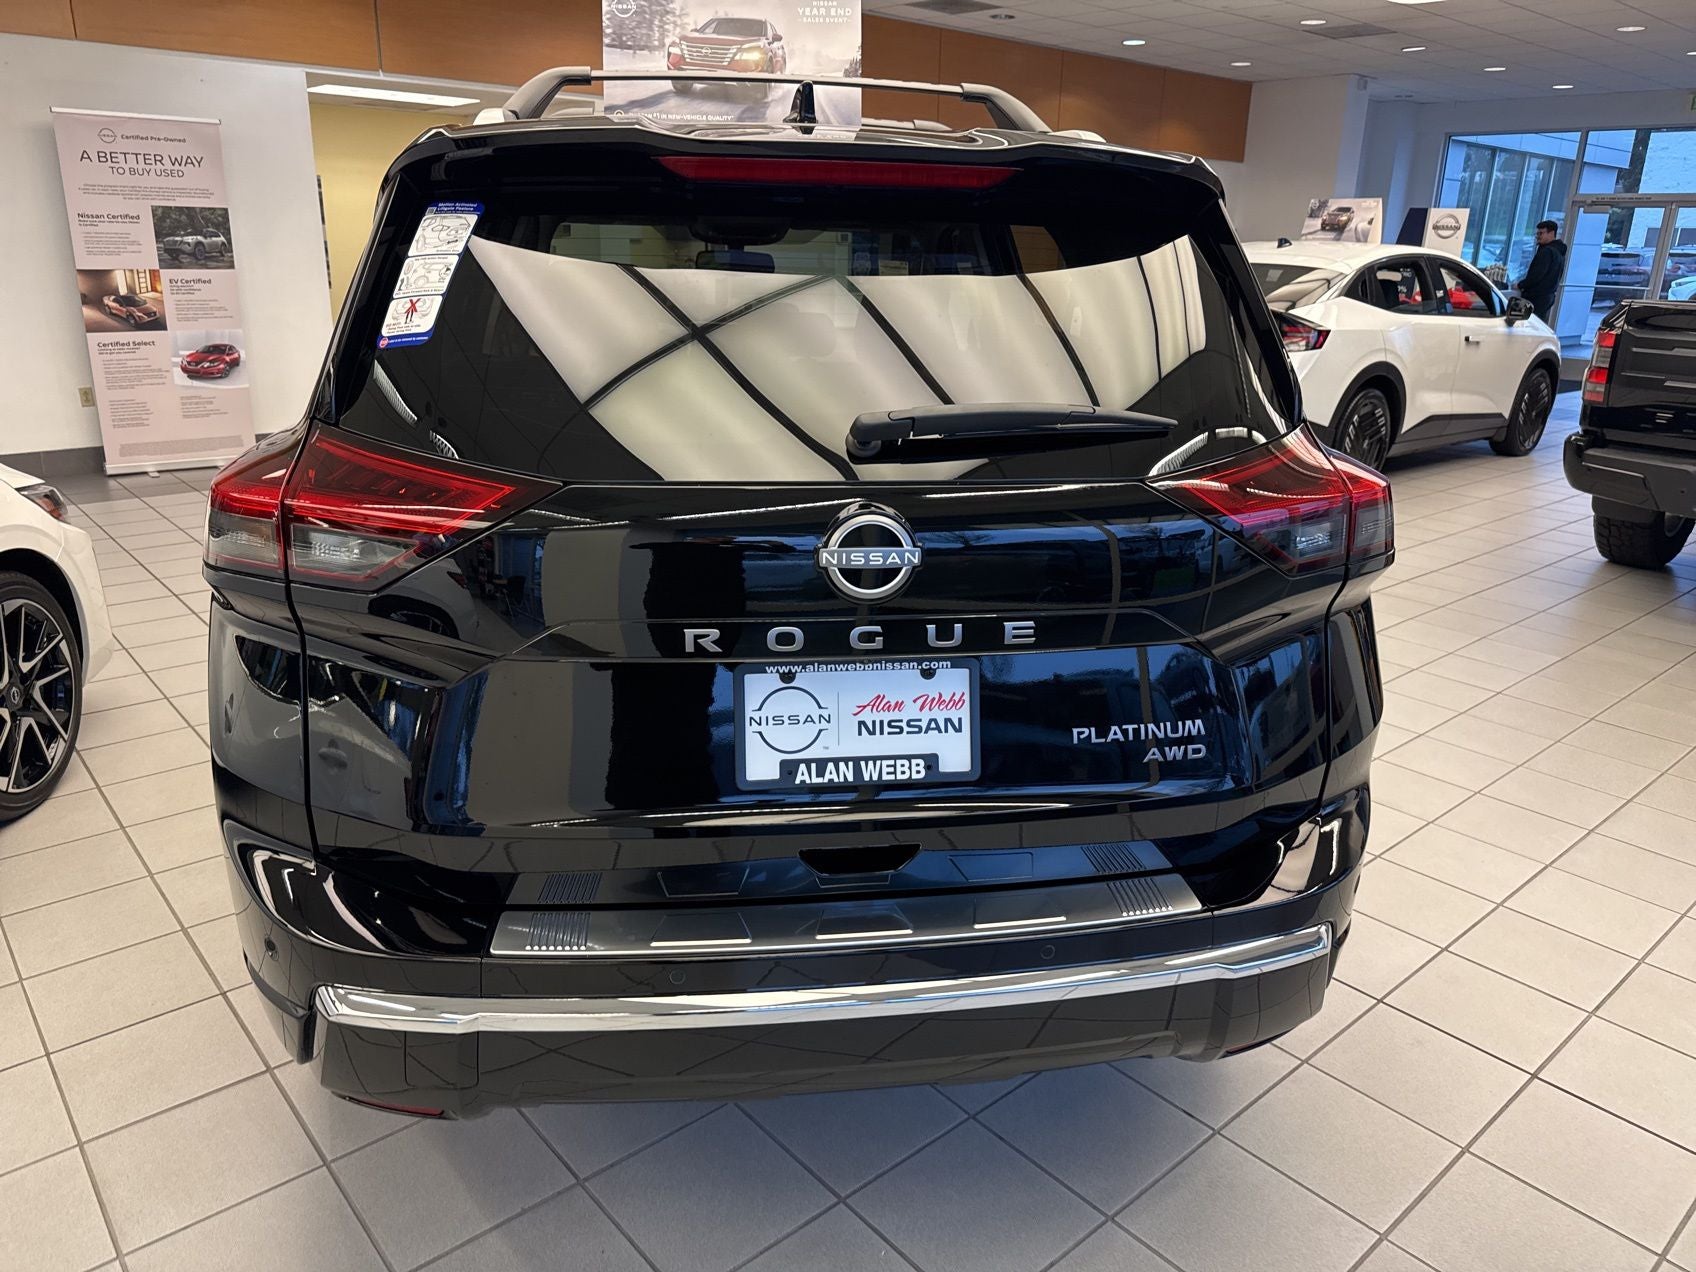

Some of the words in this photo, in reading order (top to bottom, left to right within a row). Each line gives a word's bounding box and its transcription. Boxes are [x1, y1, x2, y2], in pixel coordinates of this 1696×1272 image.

[797, 7, 826, 16] YEAR
[830, 7, 852, 16] END
[150, 135, 186, 143] Pre-Owned
[80, 150, 93, 162] A
[97, 150, 165, 166] BETTER
[168, 154, 204, 168] WAY
[108, 166, 126, 175] TO
[129, 167, 152, 177] BUY
[154, 168, 185, 178] USED
[106, 213, 140, 221] Certified
[822, 551, 919, 565] NISSAN
[683, 620, 1036, 653] ROGUE
[852, 693, 905, 717] Alan
[913, 691, 966, 713] Webb
[749, 713, 831, 727] NISSAN
[857, 717, 962, 736] NISSAN
[1072, 719, 1206, 744] PLATINUM
[1142, 744, 1206, 763] AWD
[794, 760, 854, 784] ALAN
[859, 758, 926, 781] WEBB
